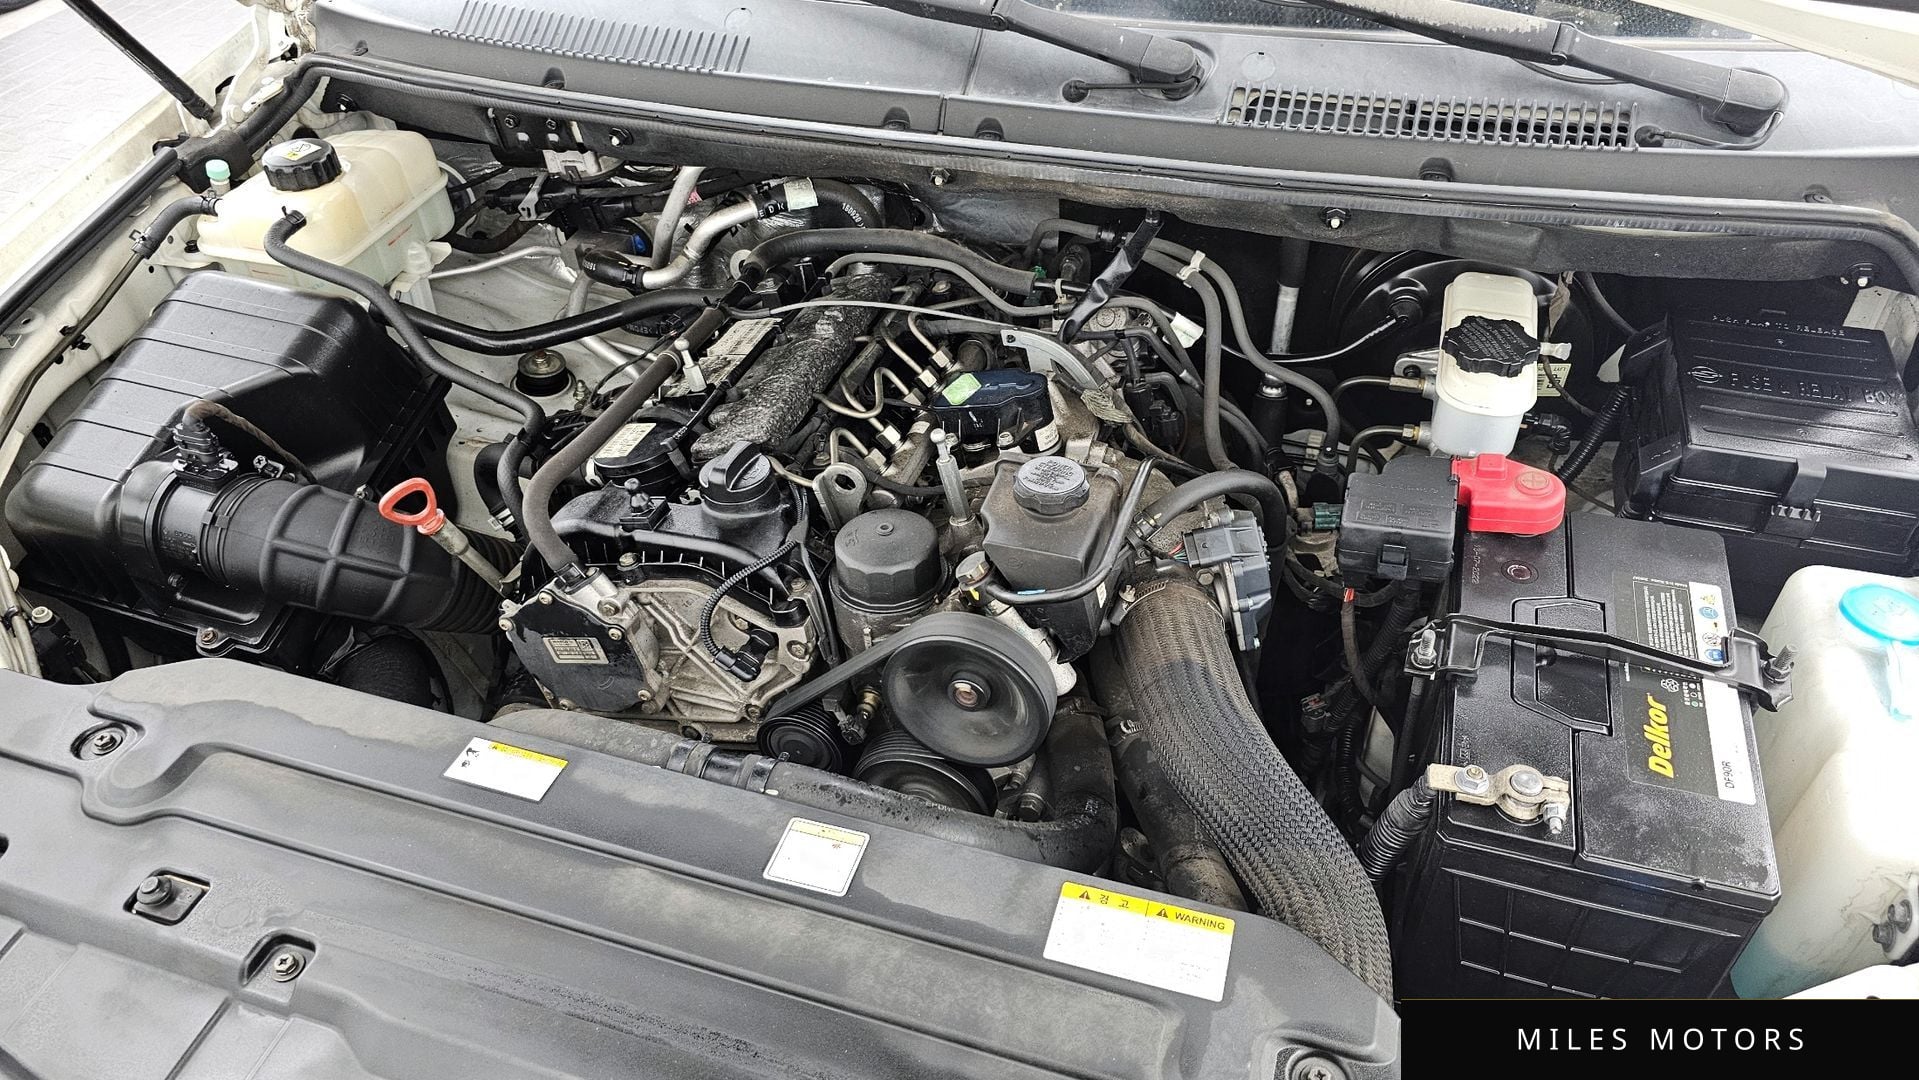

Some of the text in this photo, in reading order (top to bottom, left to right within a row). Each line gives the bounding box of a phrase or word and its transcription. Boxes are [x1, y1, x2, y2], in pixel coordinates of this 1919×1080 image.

[1643, 695, 1674, 778] Delkor
[1721, 760, 1735, 789] DF90R
[1175, 911, 1226, 930] WARNING
